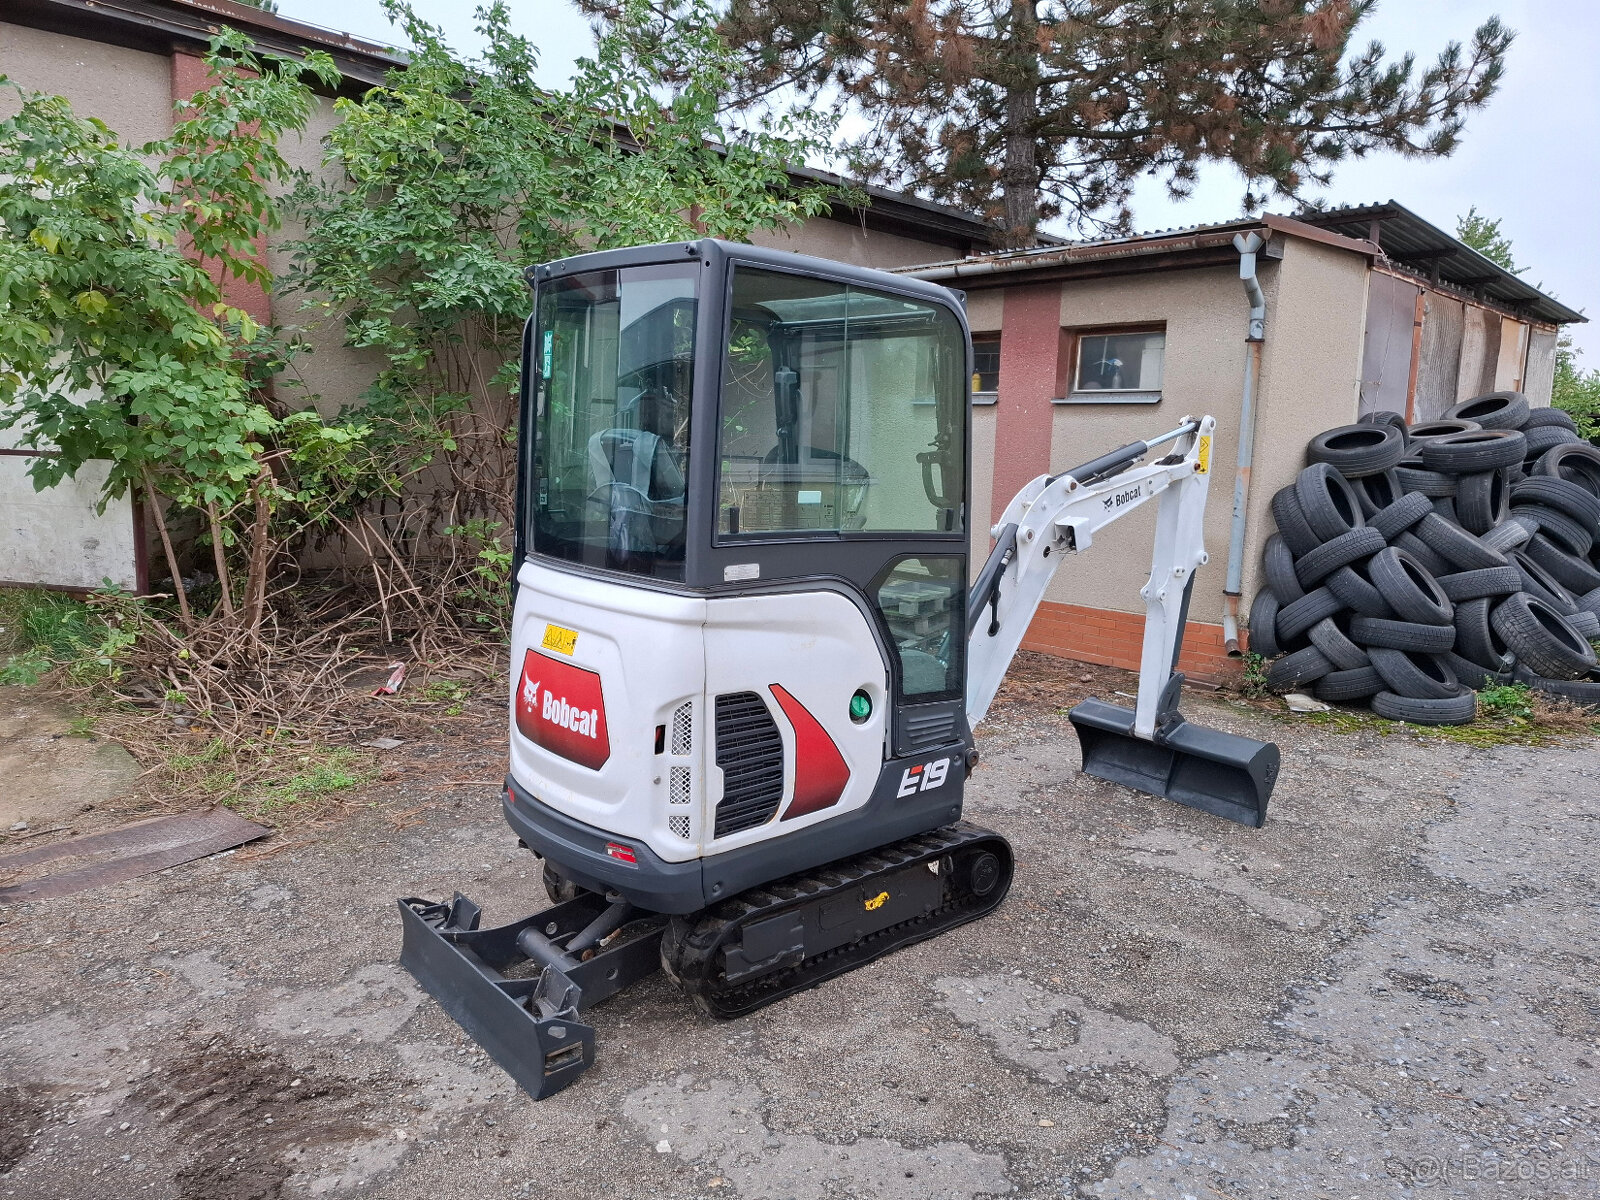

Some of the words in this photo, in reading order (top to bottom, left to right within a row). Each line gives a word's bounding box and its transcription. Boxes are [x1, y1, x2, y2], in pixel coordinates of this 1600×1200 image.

[1115, 485, 1141, 507] Bobcat
[542, 690, 598, 739] Bobcat
[896, 757, 950, 799] E19
